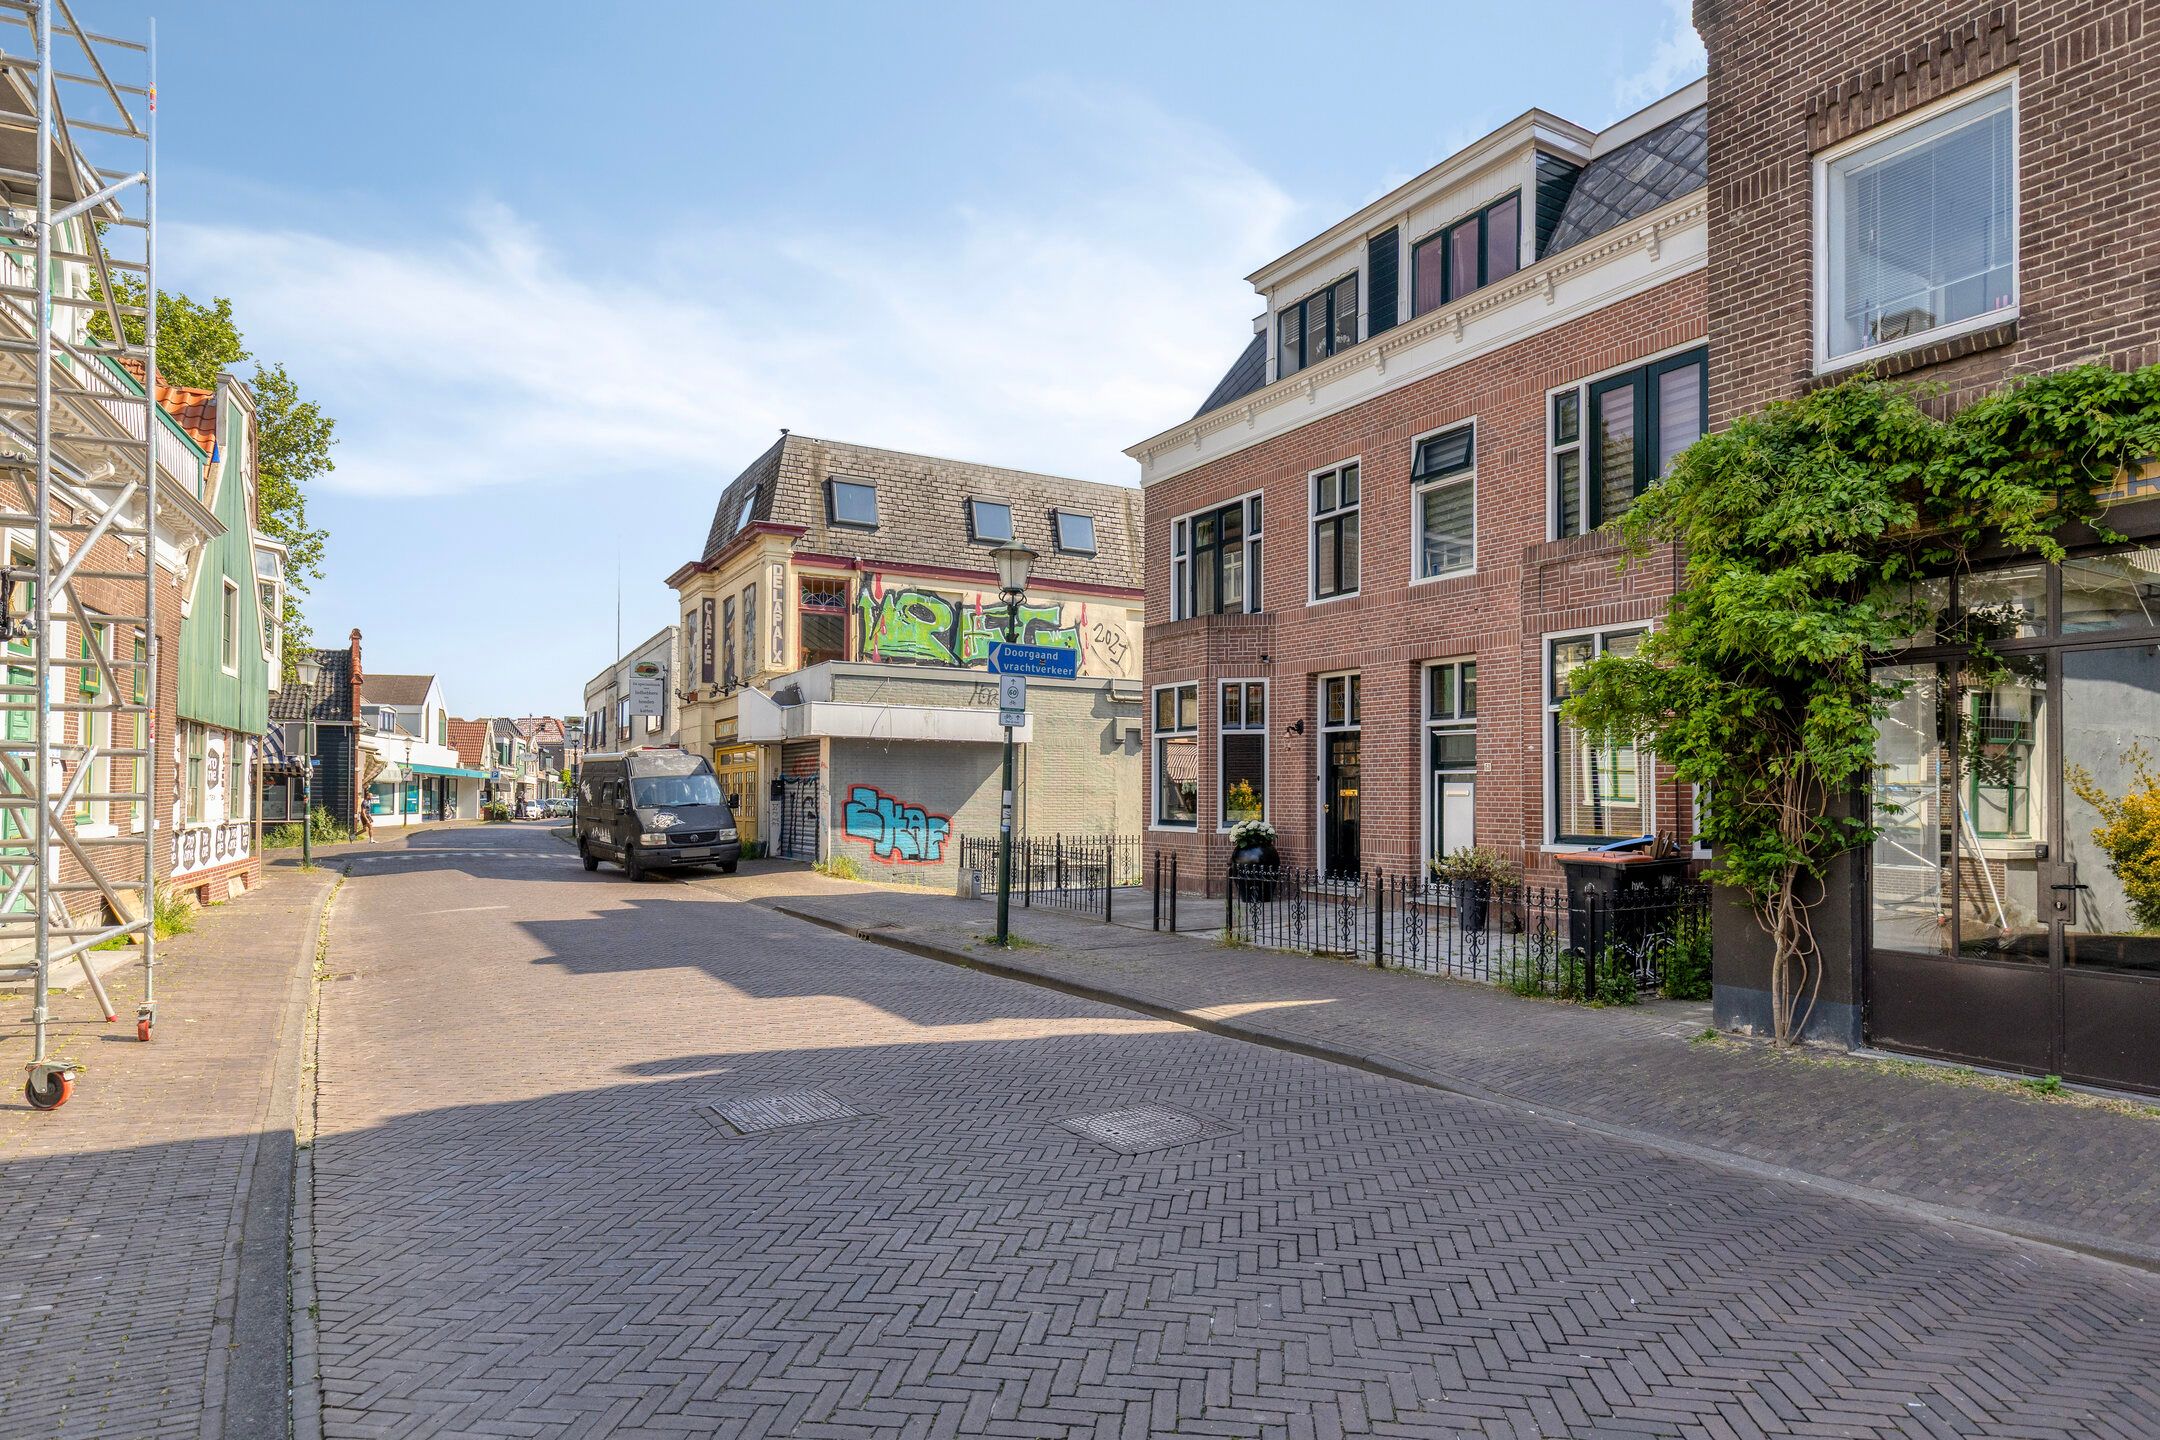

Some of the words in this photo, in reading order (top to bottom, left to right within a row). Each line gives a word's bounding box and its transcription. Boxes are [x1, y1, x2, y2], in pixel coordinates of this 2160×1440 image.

[704, 600, 713, 665] CAFÉ
[1004, 647, 1059, 661] Doorgaand
[1003, 662, 1074, 676] vrachtverkeer
